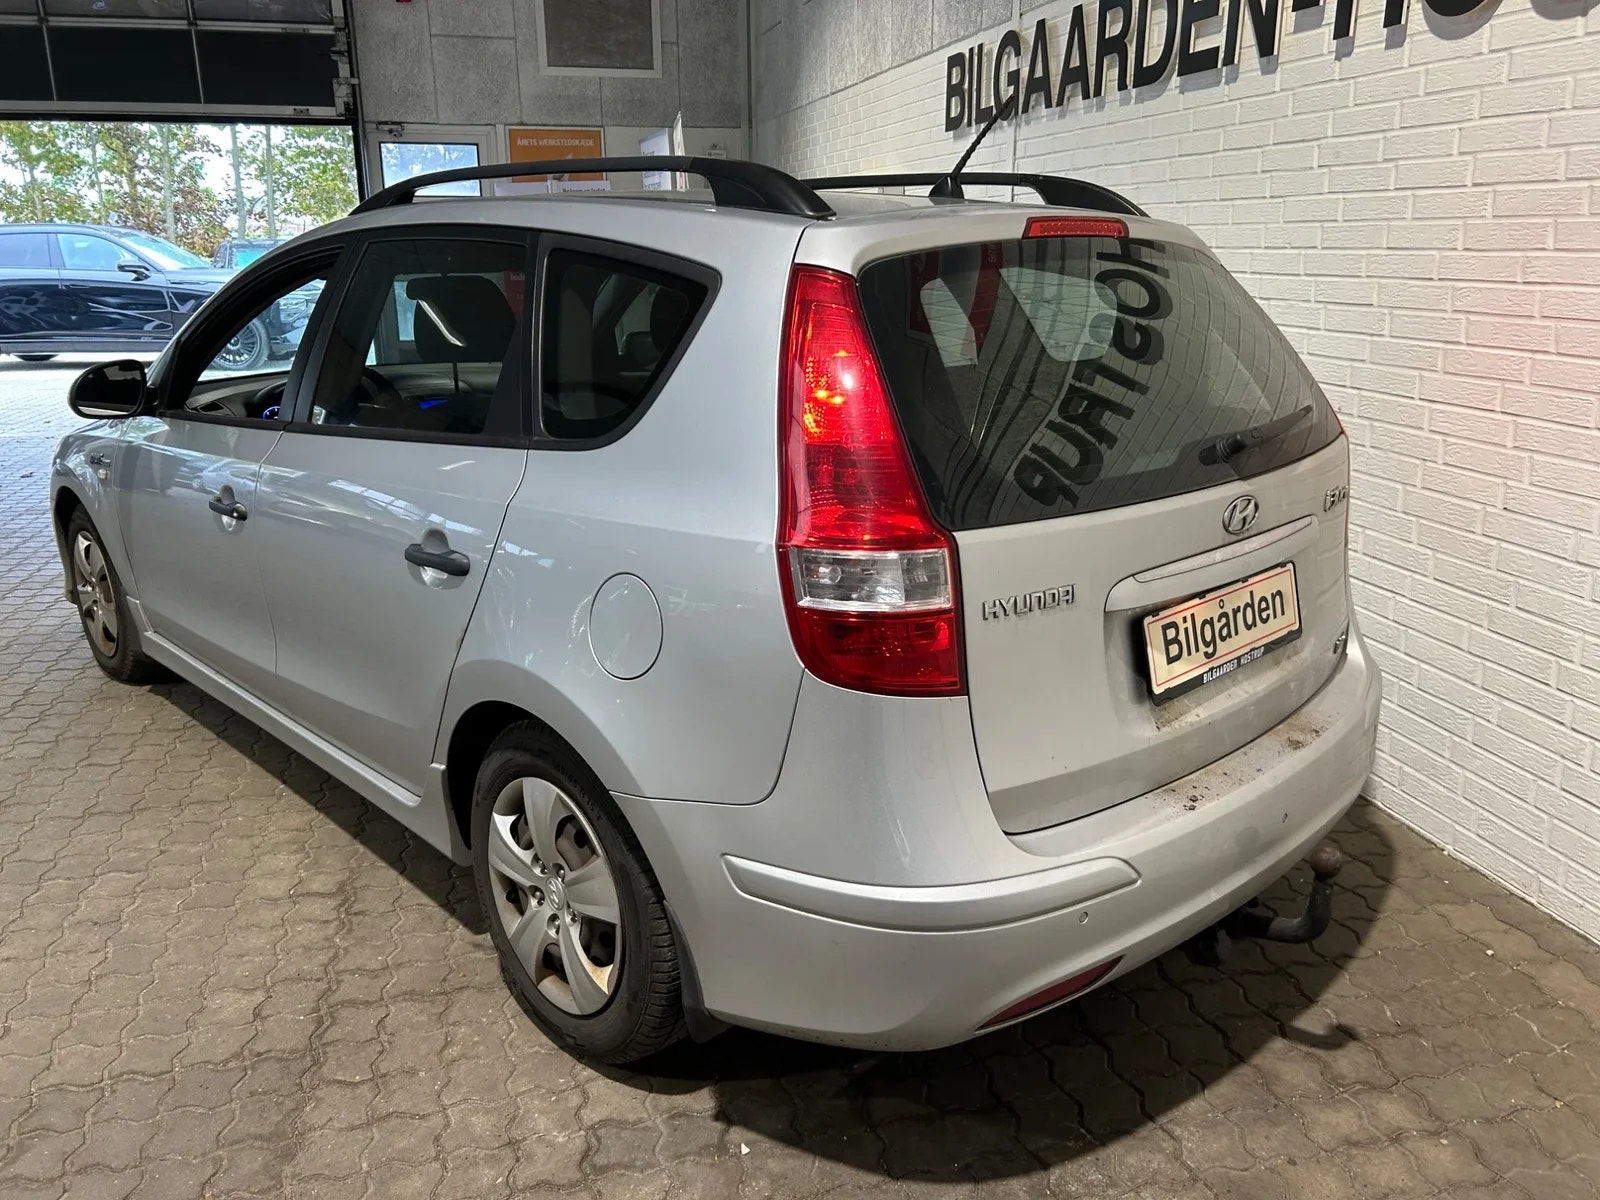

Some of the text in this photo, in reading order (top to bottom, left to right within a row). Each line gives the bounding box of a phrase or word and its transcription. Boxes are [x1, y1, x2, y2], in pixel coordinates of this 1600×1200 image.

[1161, 588, 1285, 665] Bilgården
[1203, 646, 1265, 684] BILGAARDEN HOSTRUP
